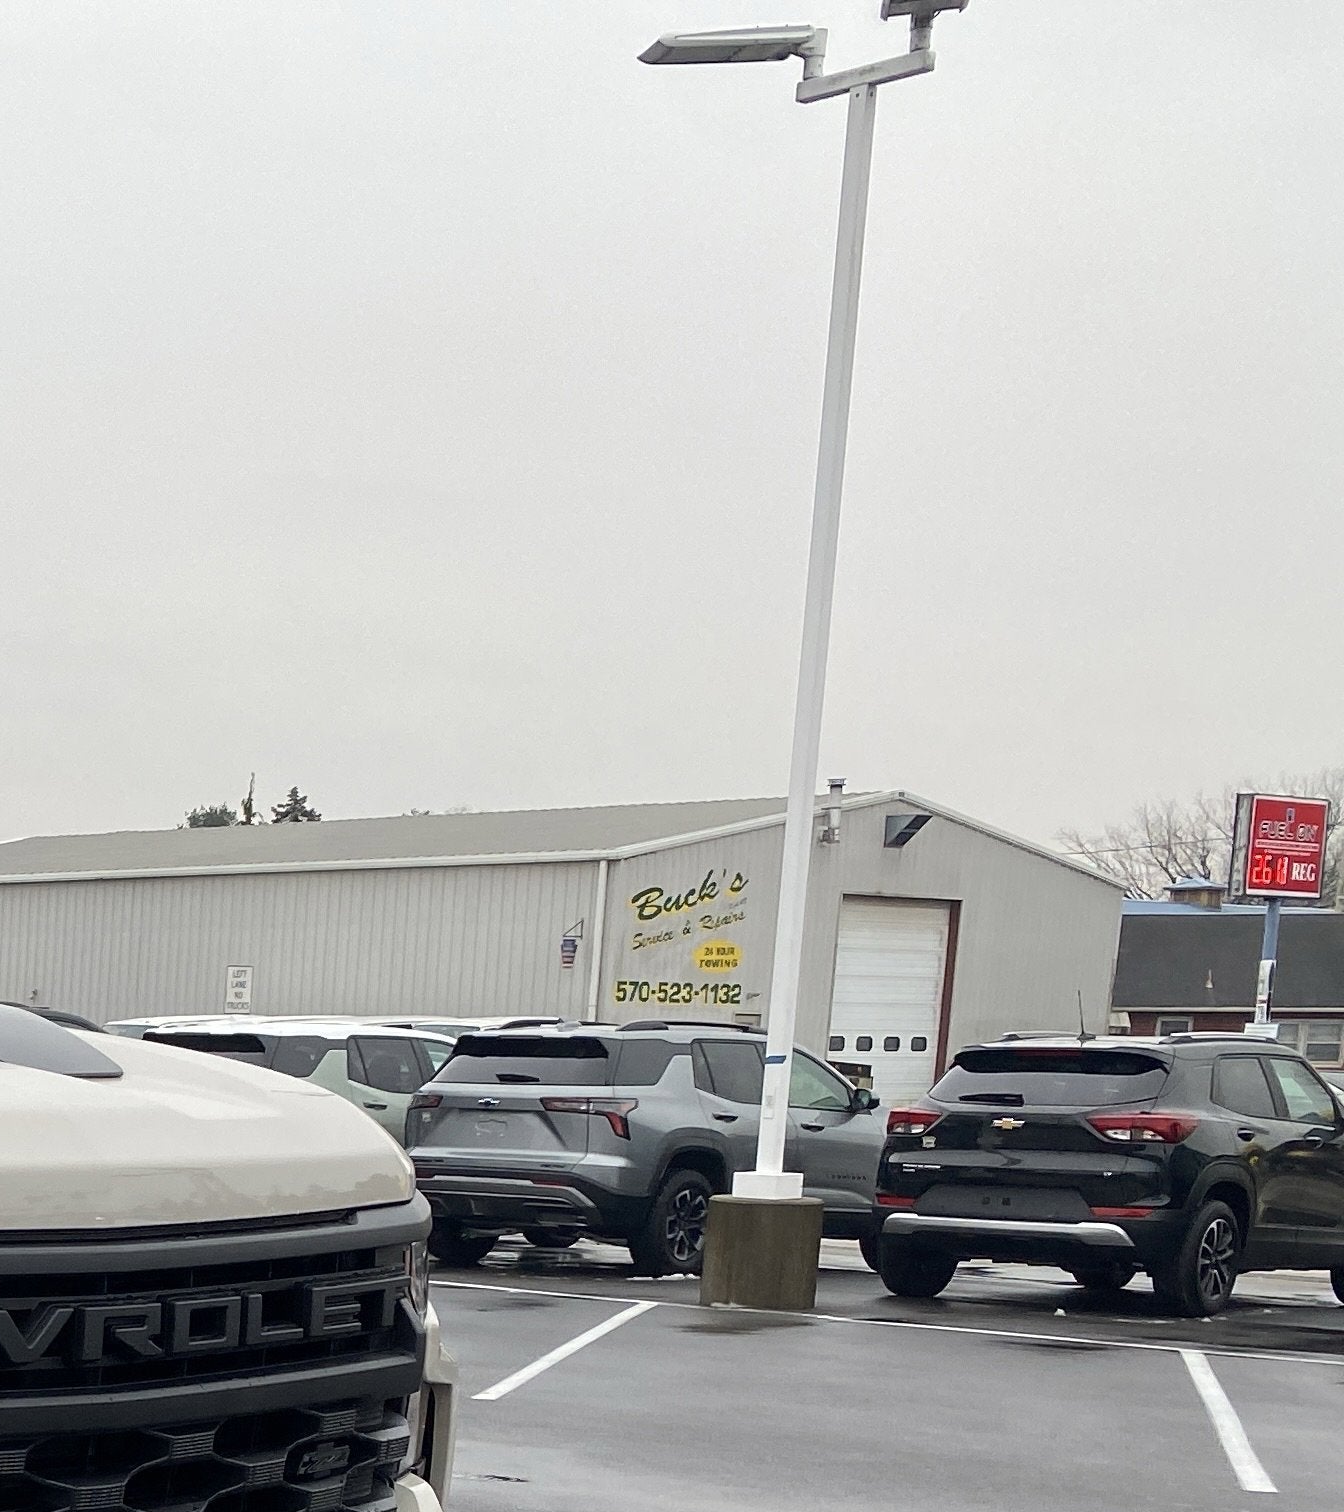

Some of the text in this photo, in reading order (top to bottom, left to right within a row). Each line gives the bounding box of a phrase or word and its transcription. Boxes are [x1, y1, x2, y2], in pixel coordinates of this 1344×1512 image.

[1259, 820, 1294, 840] FUEL
[1291, 862, 1317, 882] REG
[631, 868, 750, 920] Buck's
[699, 959, 738, 968] TOWING
[615, 980, 742, 1005] 570-523-1132
